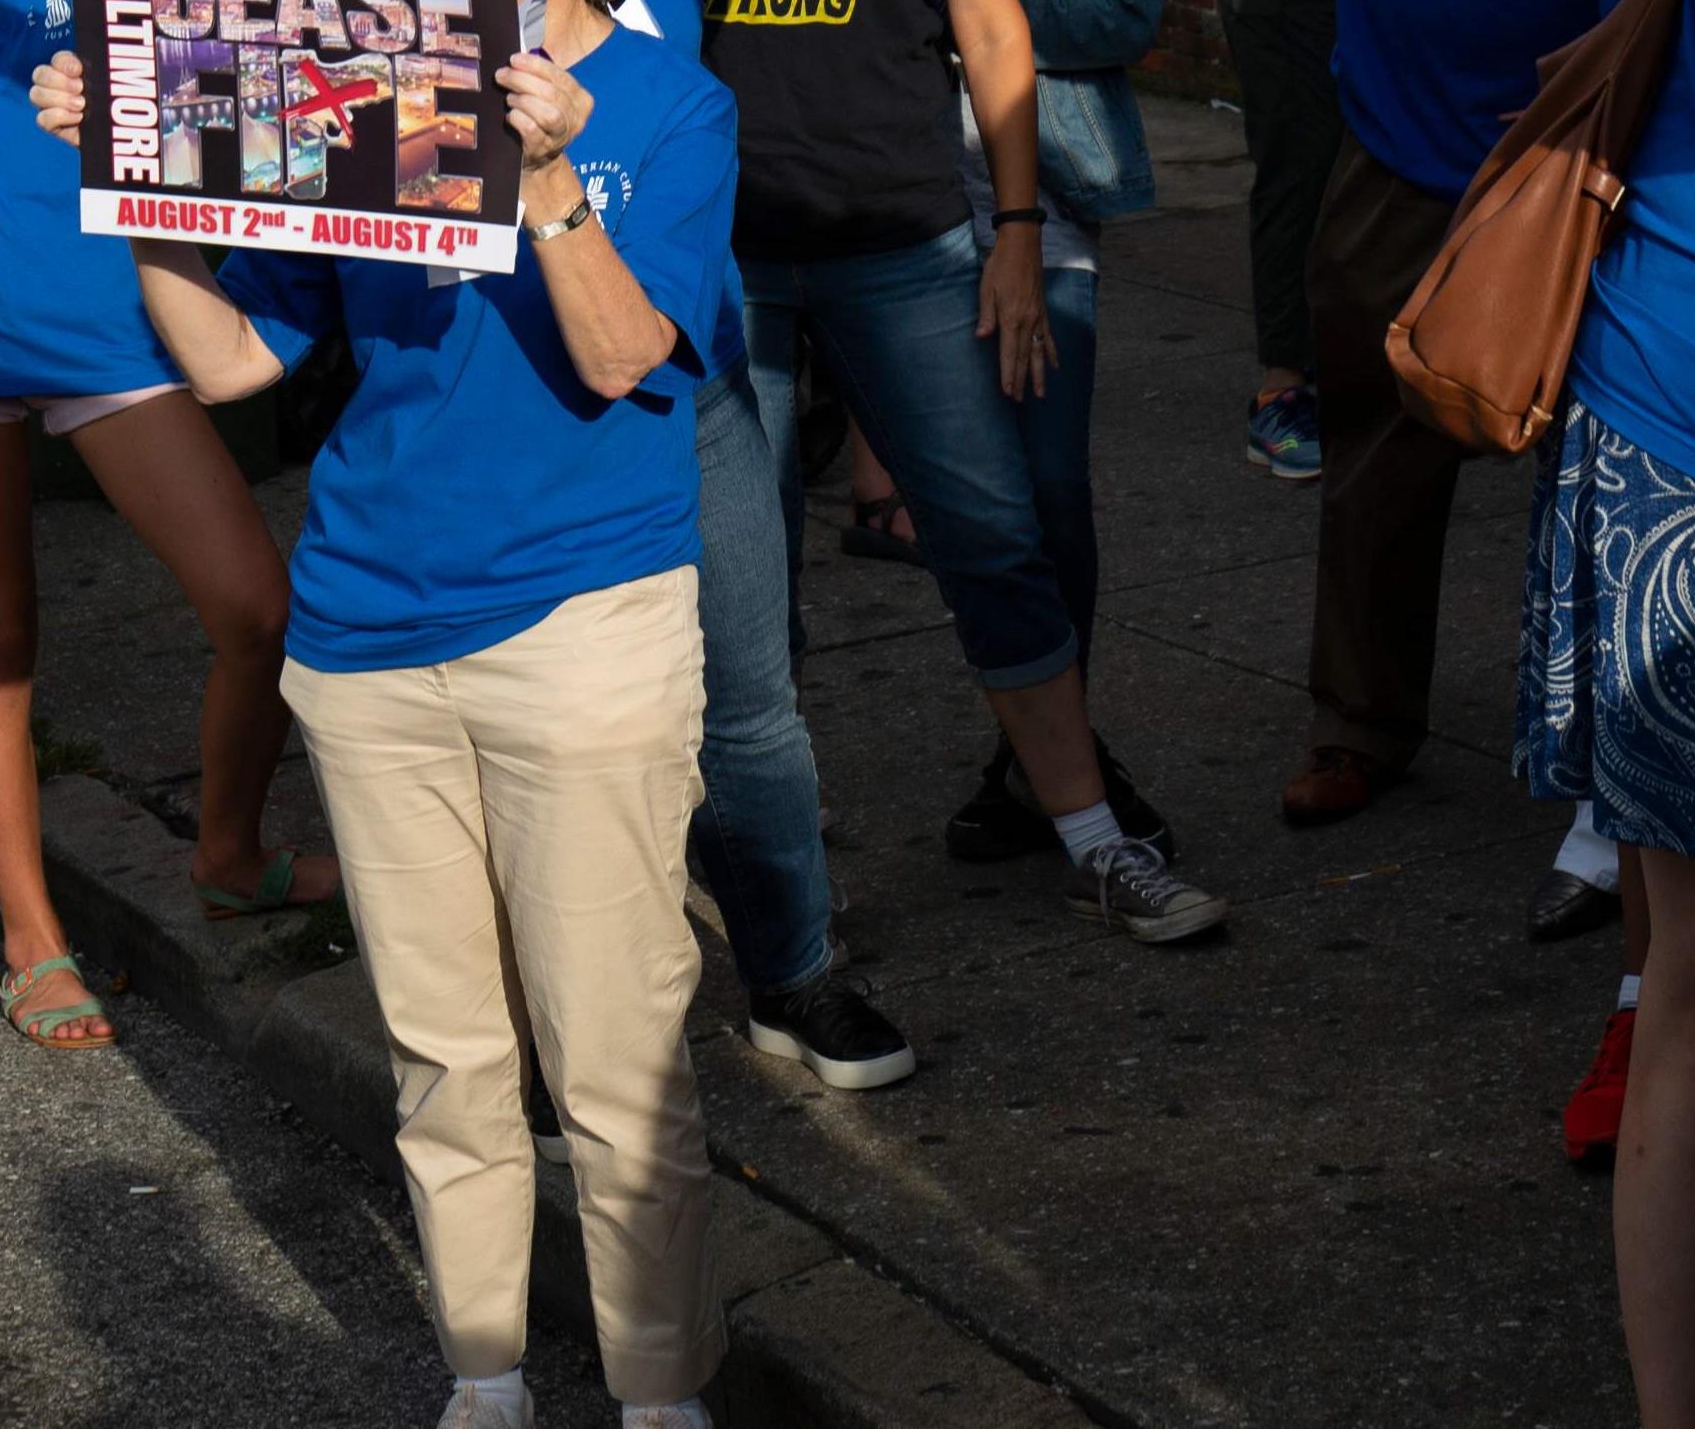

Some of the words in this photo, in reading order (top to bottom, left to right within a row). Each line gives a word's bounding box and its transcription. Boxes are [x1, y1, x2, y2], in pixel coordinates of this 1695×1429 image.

[116, 197, 236, 234] AUGUST
[242, 207, 285, 238] 2nd
[311, 212, 431, 253] AUGUST
[437, 224, 478, 256] 4TH
